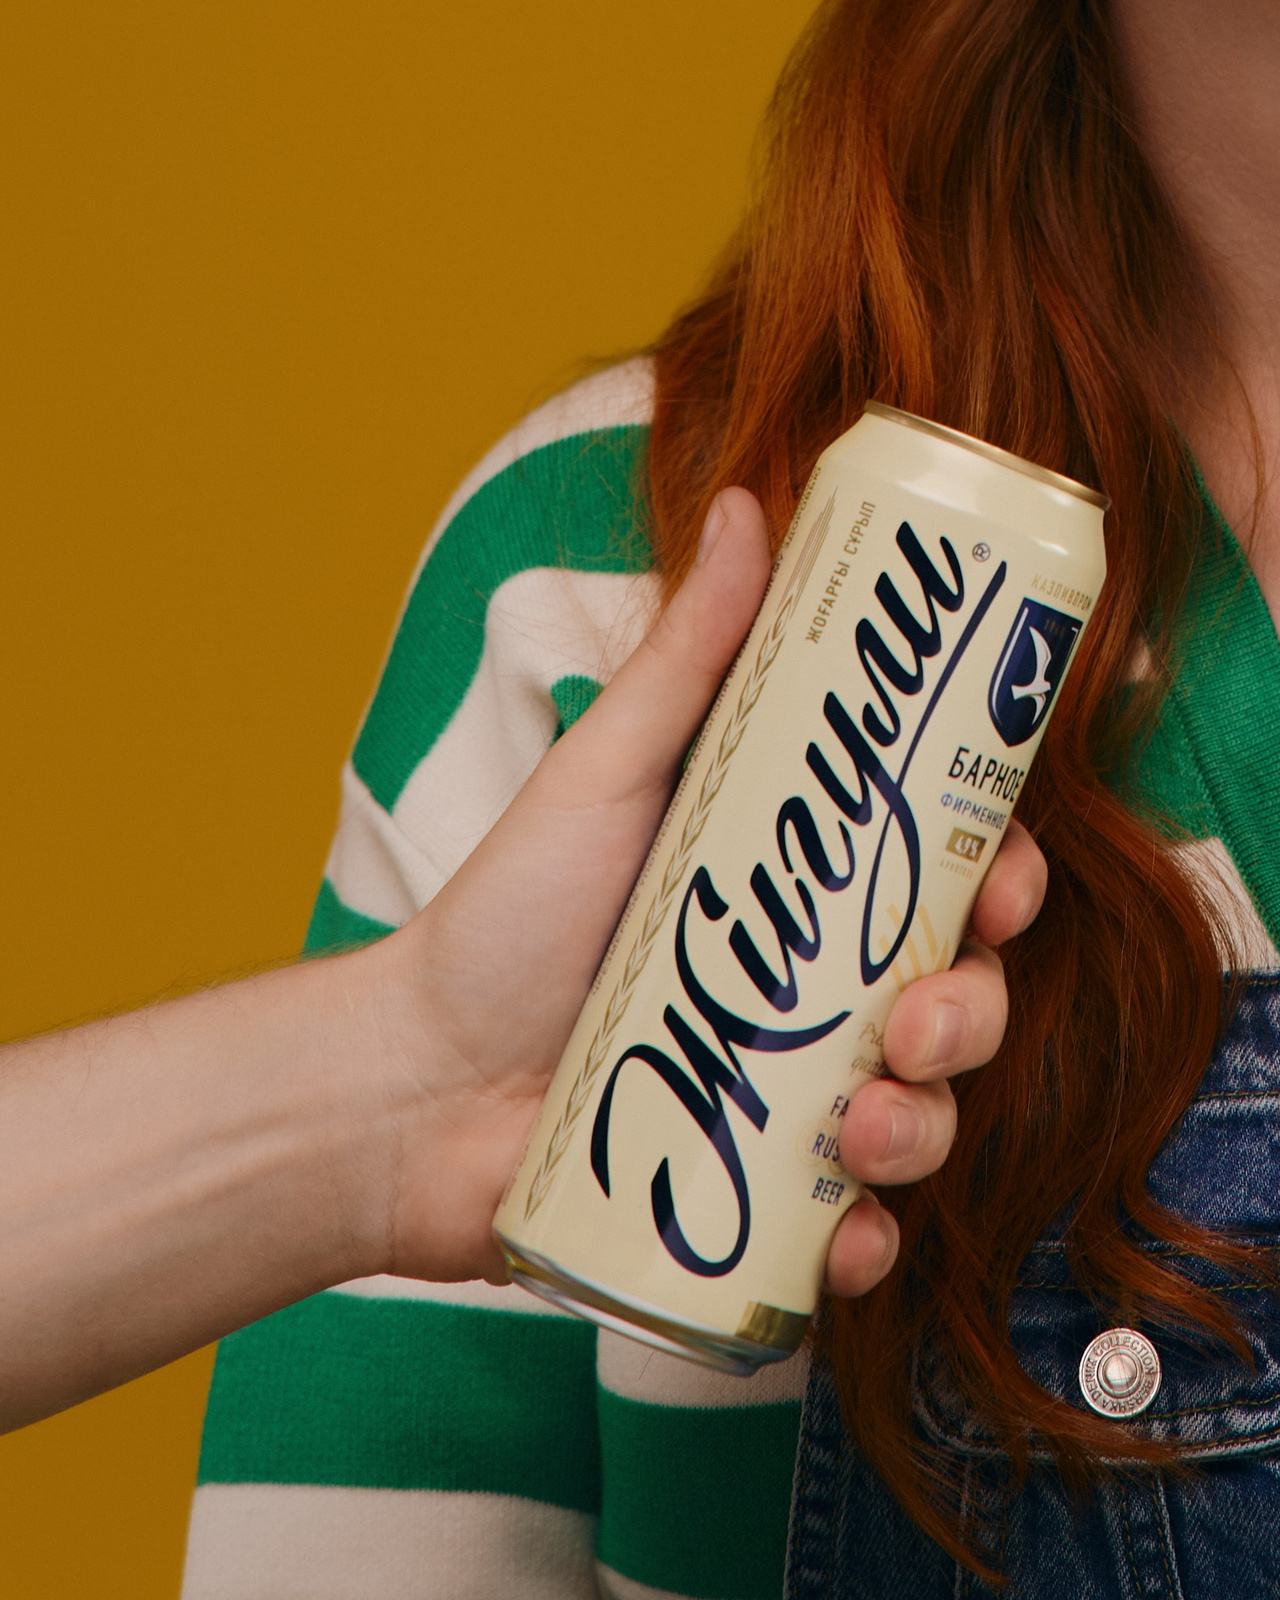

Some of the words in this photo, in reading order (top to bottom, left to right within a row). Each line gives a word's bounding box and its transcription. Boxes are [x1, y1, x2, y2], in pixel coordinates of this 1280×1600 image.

[947, 745, 1025, 803] БАРНОЕ
[940, 791, 1007, 831] ФИРМЕННОЕ
[590, 520, 1007, 1279] Жигули
[811, 1176, 845, 1206] BEER
[1094, 1333, 1157, 1376] COLLECTION
